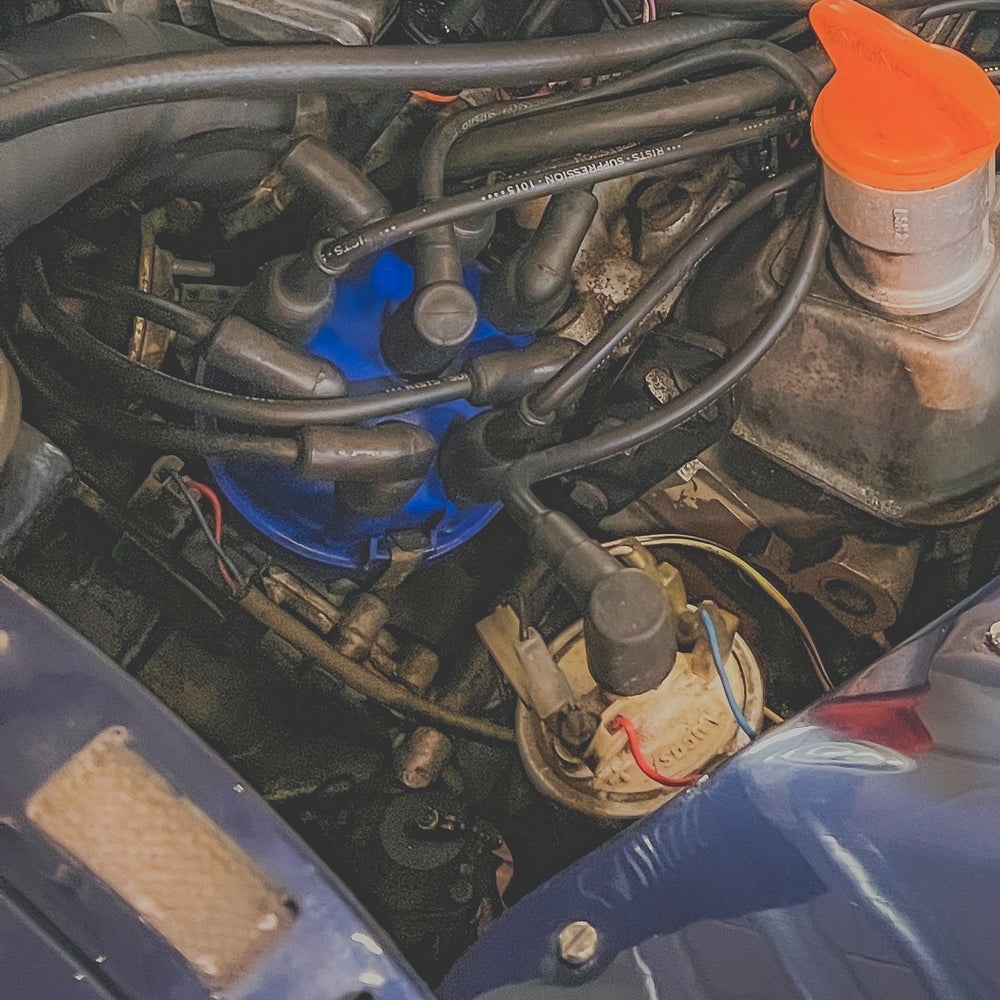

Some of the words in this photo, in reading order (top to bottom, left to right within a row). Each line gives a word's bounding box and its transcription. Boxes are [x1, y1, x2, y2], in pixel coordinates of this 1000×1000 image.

[631, 147, 665, 162] RISTS
[544, 156, 625, 186] SUPPRESSION
[506, 180, 536, 196] 1015
